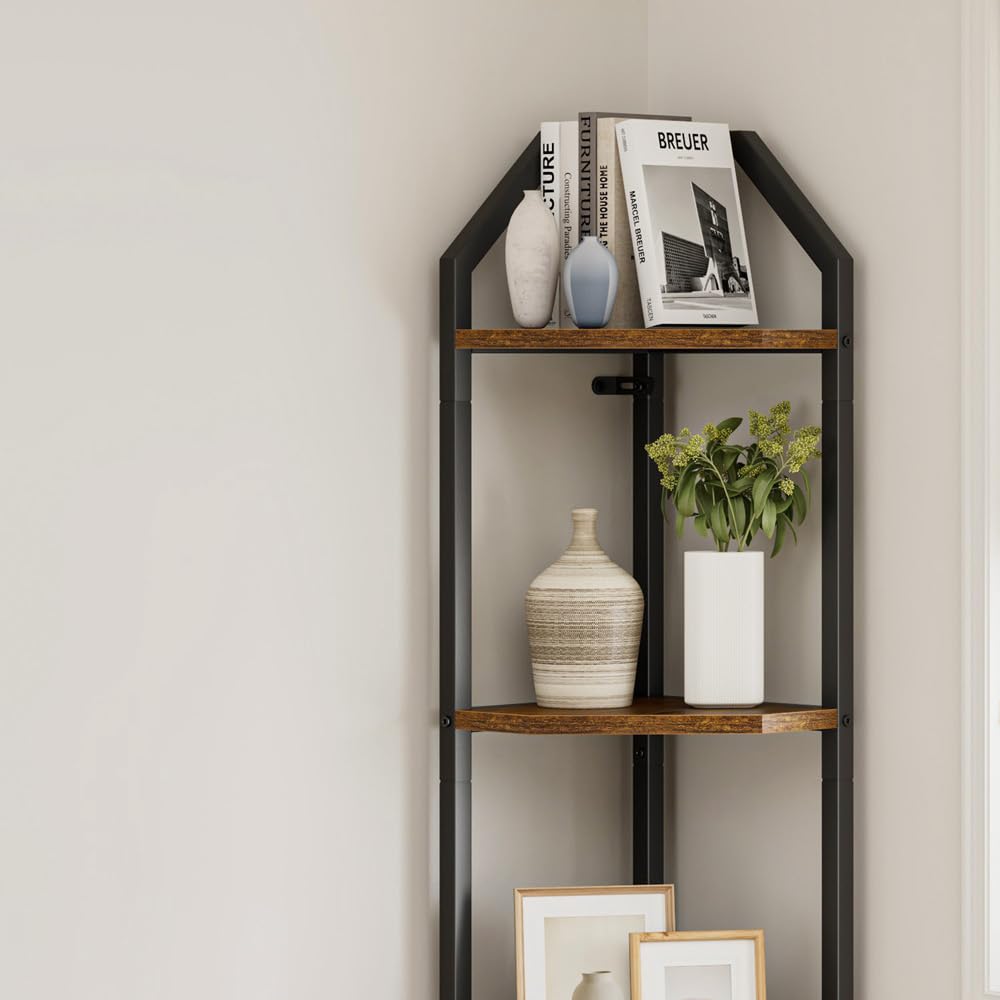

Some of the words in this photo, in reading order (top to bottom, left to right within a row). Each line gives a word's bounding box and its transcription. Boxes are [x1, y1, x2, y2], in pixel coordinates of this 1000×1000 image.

[657, 132, 709, 151] BREUER
[600, 165, 608, 189] HOME
[562, 172, 572, 224] Constructing
[600, 191, 608, 219] HOUSE
[600, 222, 608, 240] THE
[629, 190, 640, 227] MARCEL
[635, 228, 646, 264] BREUER
